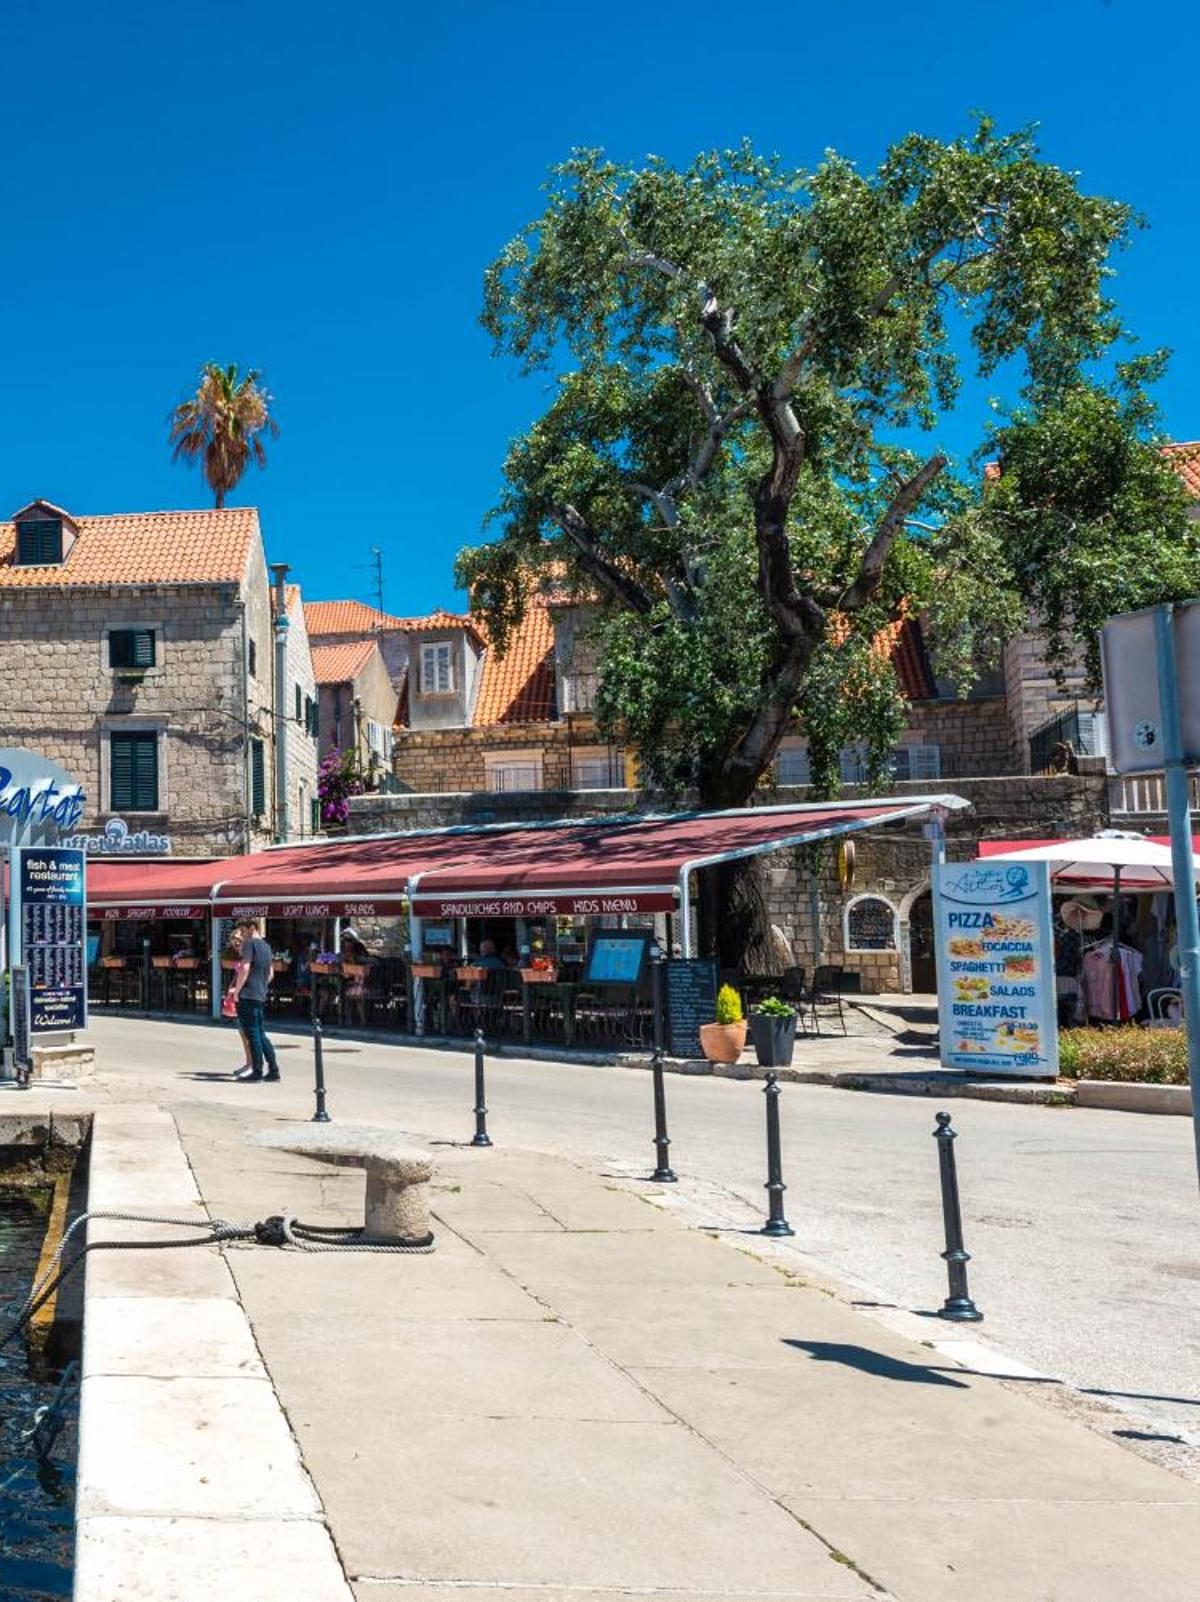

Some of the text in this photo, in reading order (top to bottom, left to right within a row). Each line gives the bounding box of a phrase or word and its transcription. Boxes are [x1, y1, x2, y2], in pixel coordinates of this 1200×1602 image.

[58, 831, 170, 850] uffet atlas
[26, 859, 47, 870] fish
[49, 860, 57, 870] &
[440, 901, 558, 916] SANDWICHES AND CHIPS
[573, 899, 638, 913] KIDS MENU
[948, 911, 994, 929] PIZZA
[981, 941, 1033, 952] FOCACCIA
[950, 961, 1006, 973] SPAGHETTI
[990, 985, 1036, 998] SALADS
[952, 1003, 1028, 1019] BREAKFAST
